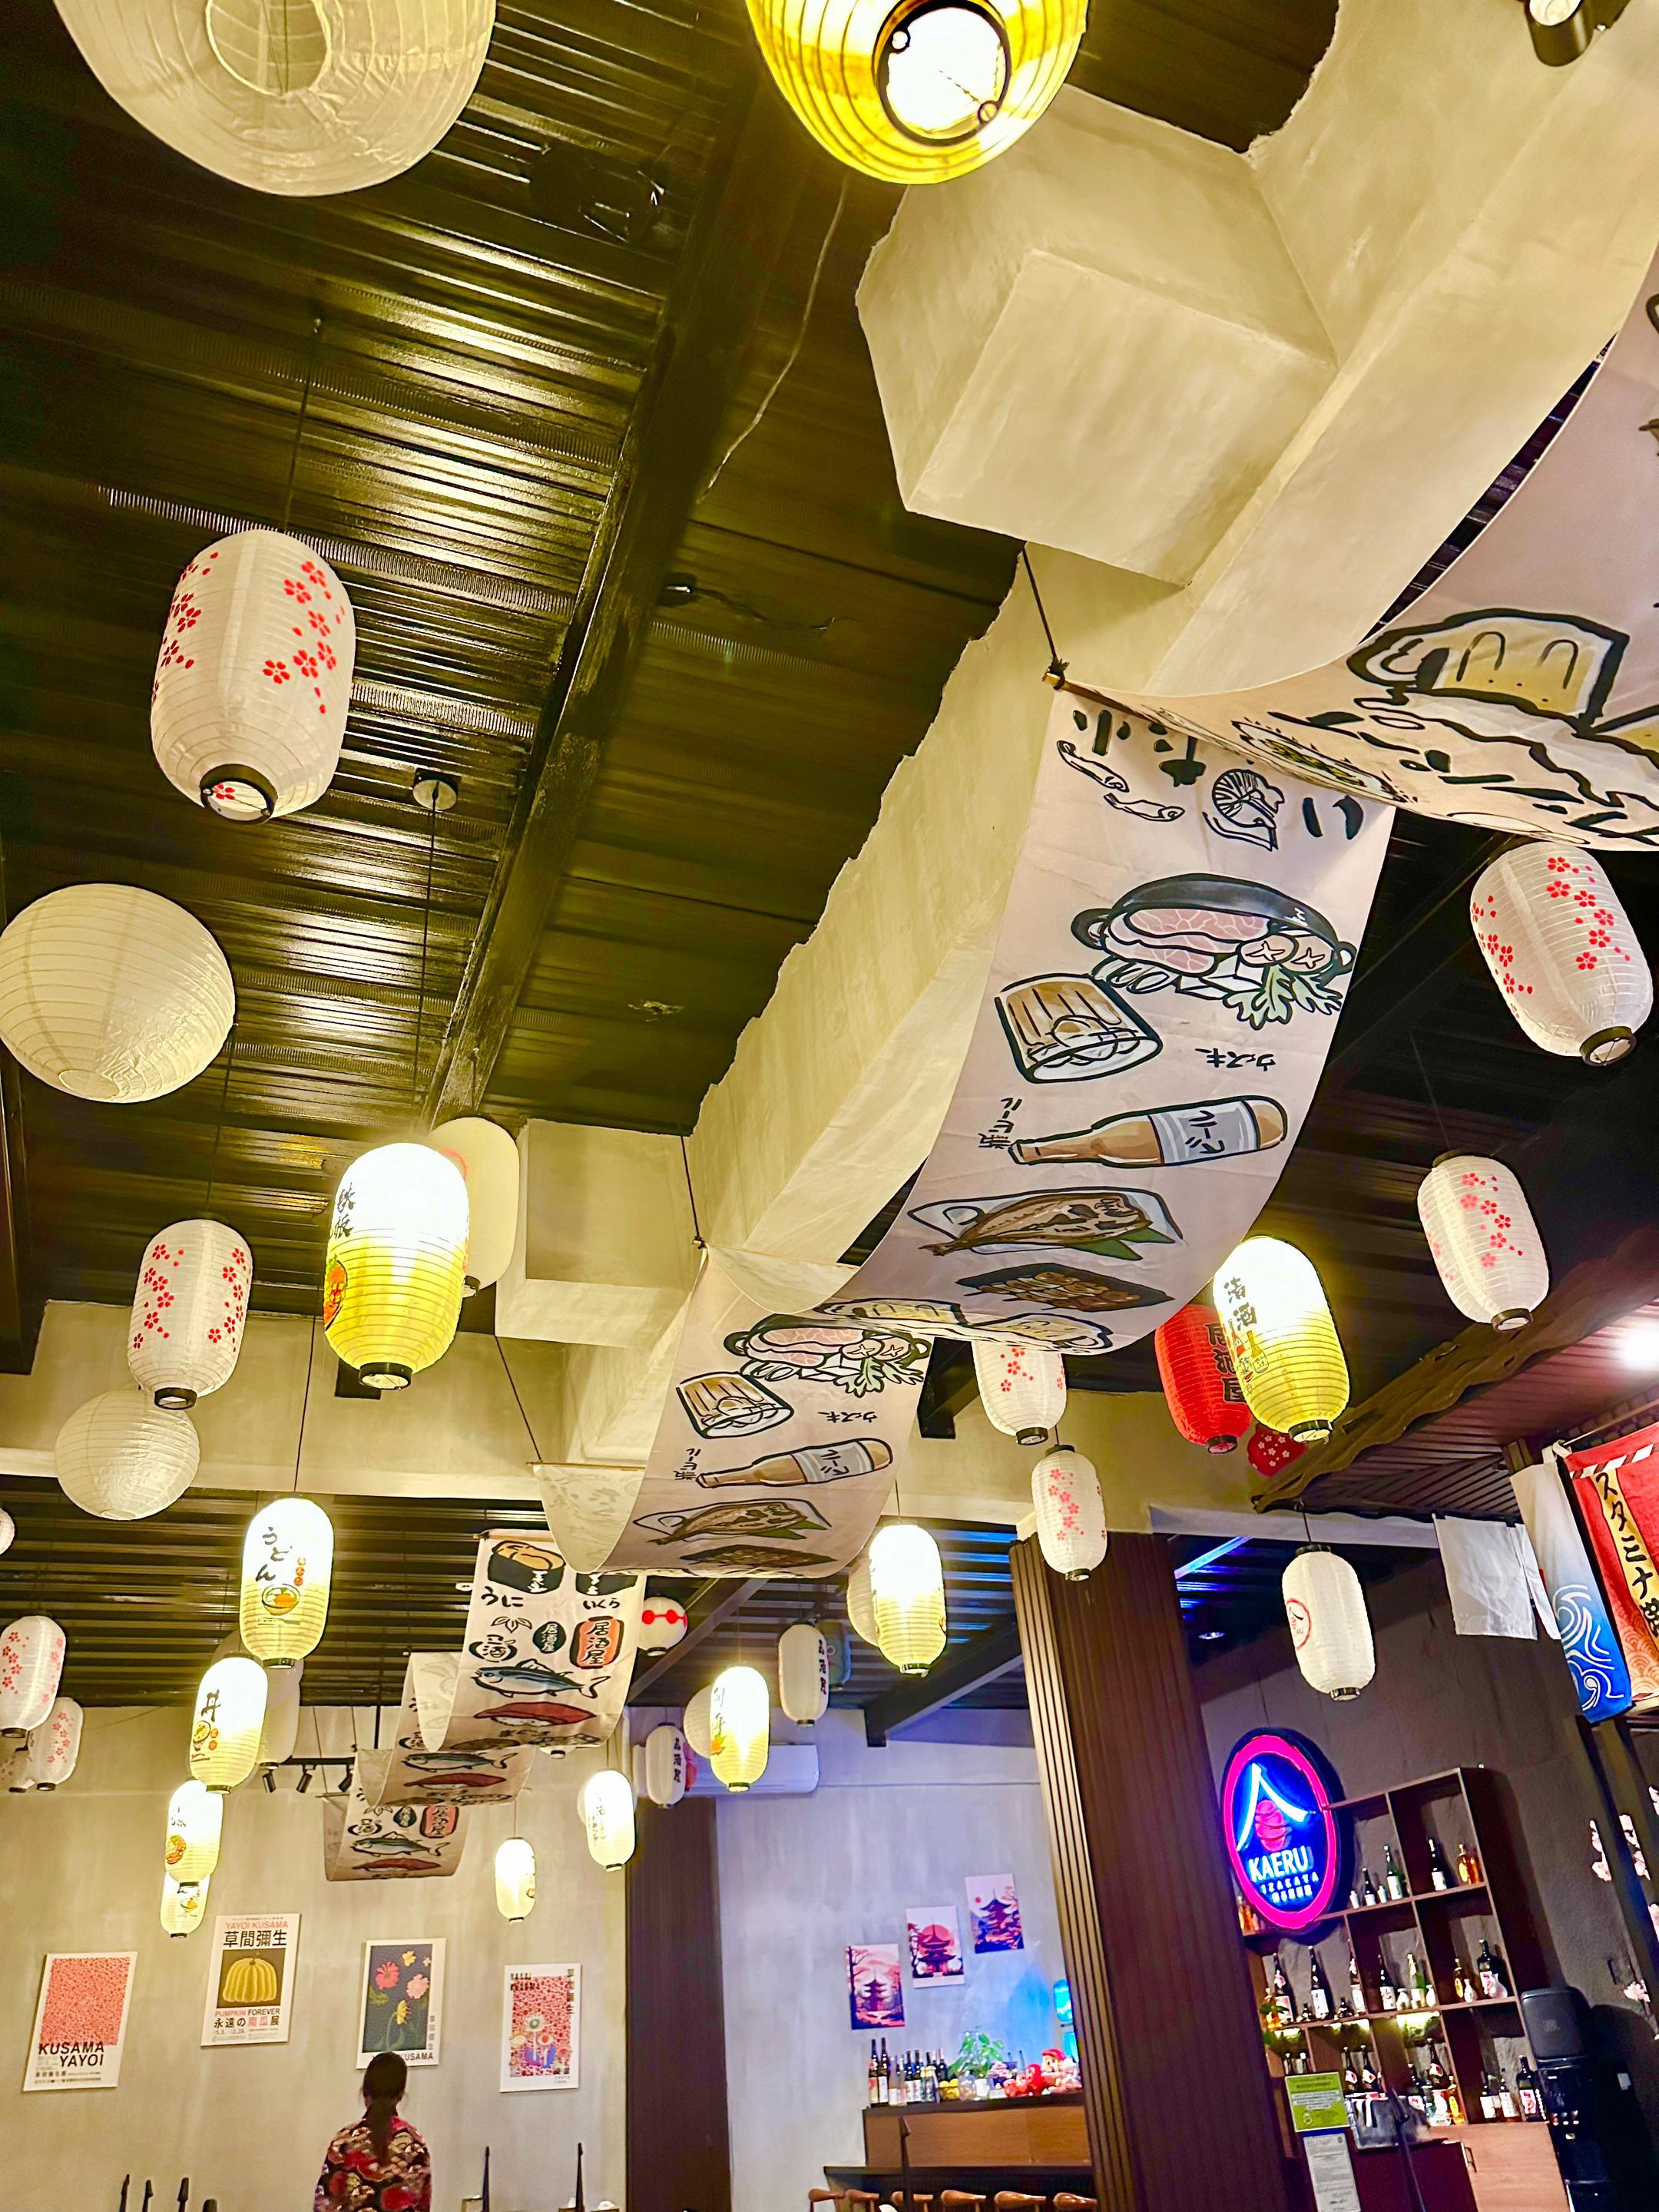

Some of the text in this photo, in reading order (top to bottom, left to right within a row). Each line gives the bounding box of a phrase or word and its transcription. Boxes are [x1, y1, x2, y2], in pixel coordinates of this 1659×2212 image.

[256, 1527, 293, 1581] うどん
[583, 1598, 621, 1609] いくら
[581, 1621, 611, 1665] 居酒屋
[1247, 1845, 1310, 1883] KAERU
[224, 1929, 287, 1948] 草間彌生
[247, 2008, 280, 2016] FOREVER
[38, 2041, 104, 2055] KUSAMA
[60, 2054, 104, 2067] YAYOI
[402, 2051, 434, 2061] USAMA
